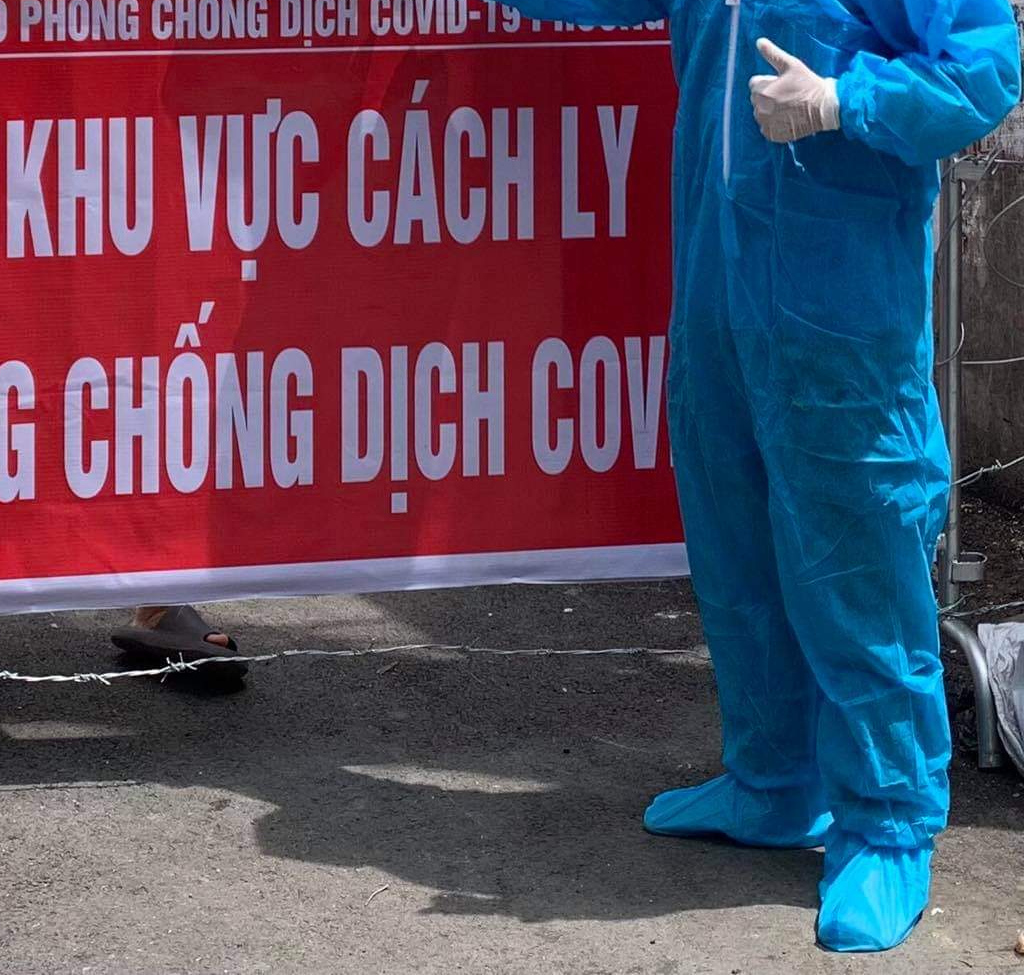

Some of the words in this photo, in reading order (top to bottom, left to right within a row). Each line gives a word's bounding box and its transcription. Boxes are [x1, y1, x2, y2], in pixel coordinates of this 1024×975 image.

[6, 116, 154, 259] KHU
[178, 98, 320, 282] VỰC
[346, 79, 535, 248] CÁCH
[560, 105, 639, 240] LY
[64, 301, 314, 500] CHỐNG
[340, 340, 506, 514] DỊCH
[531, 335, 673, 476] COV
